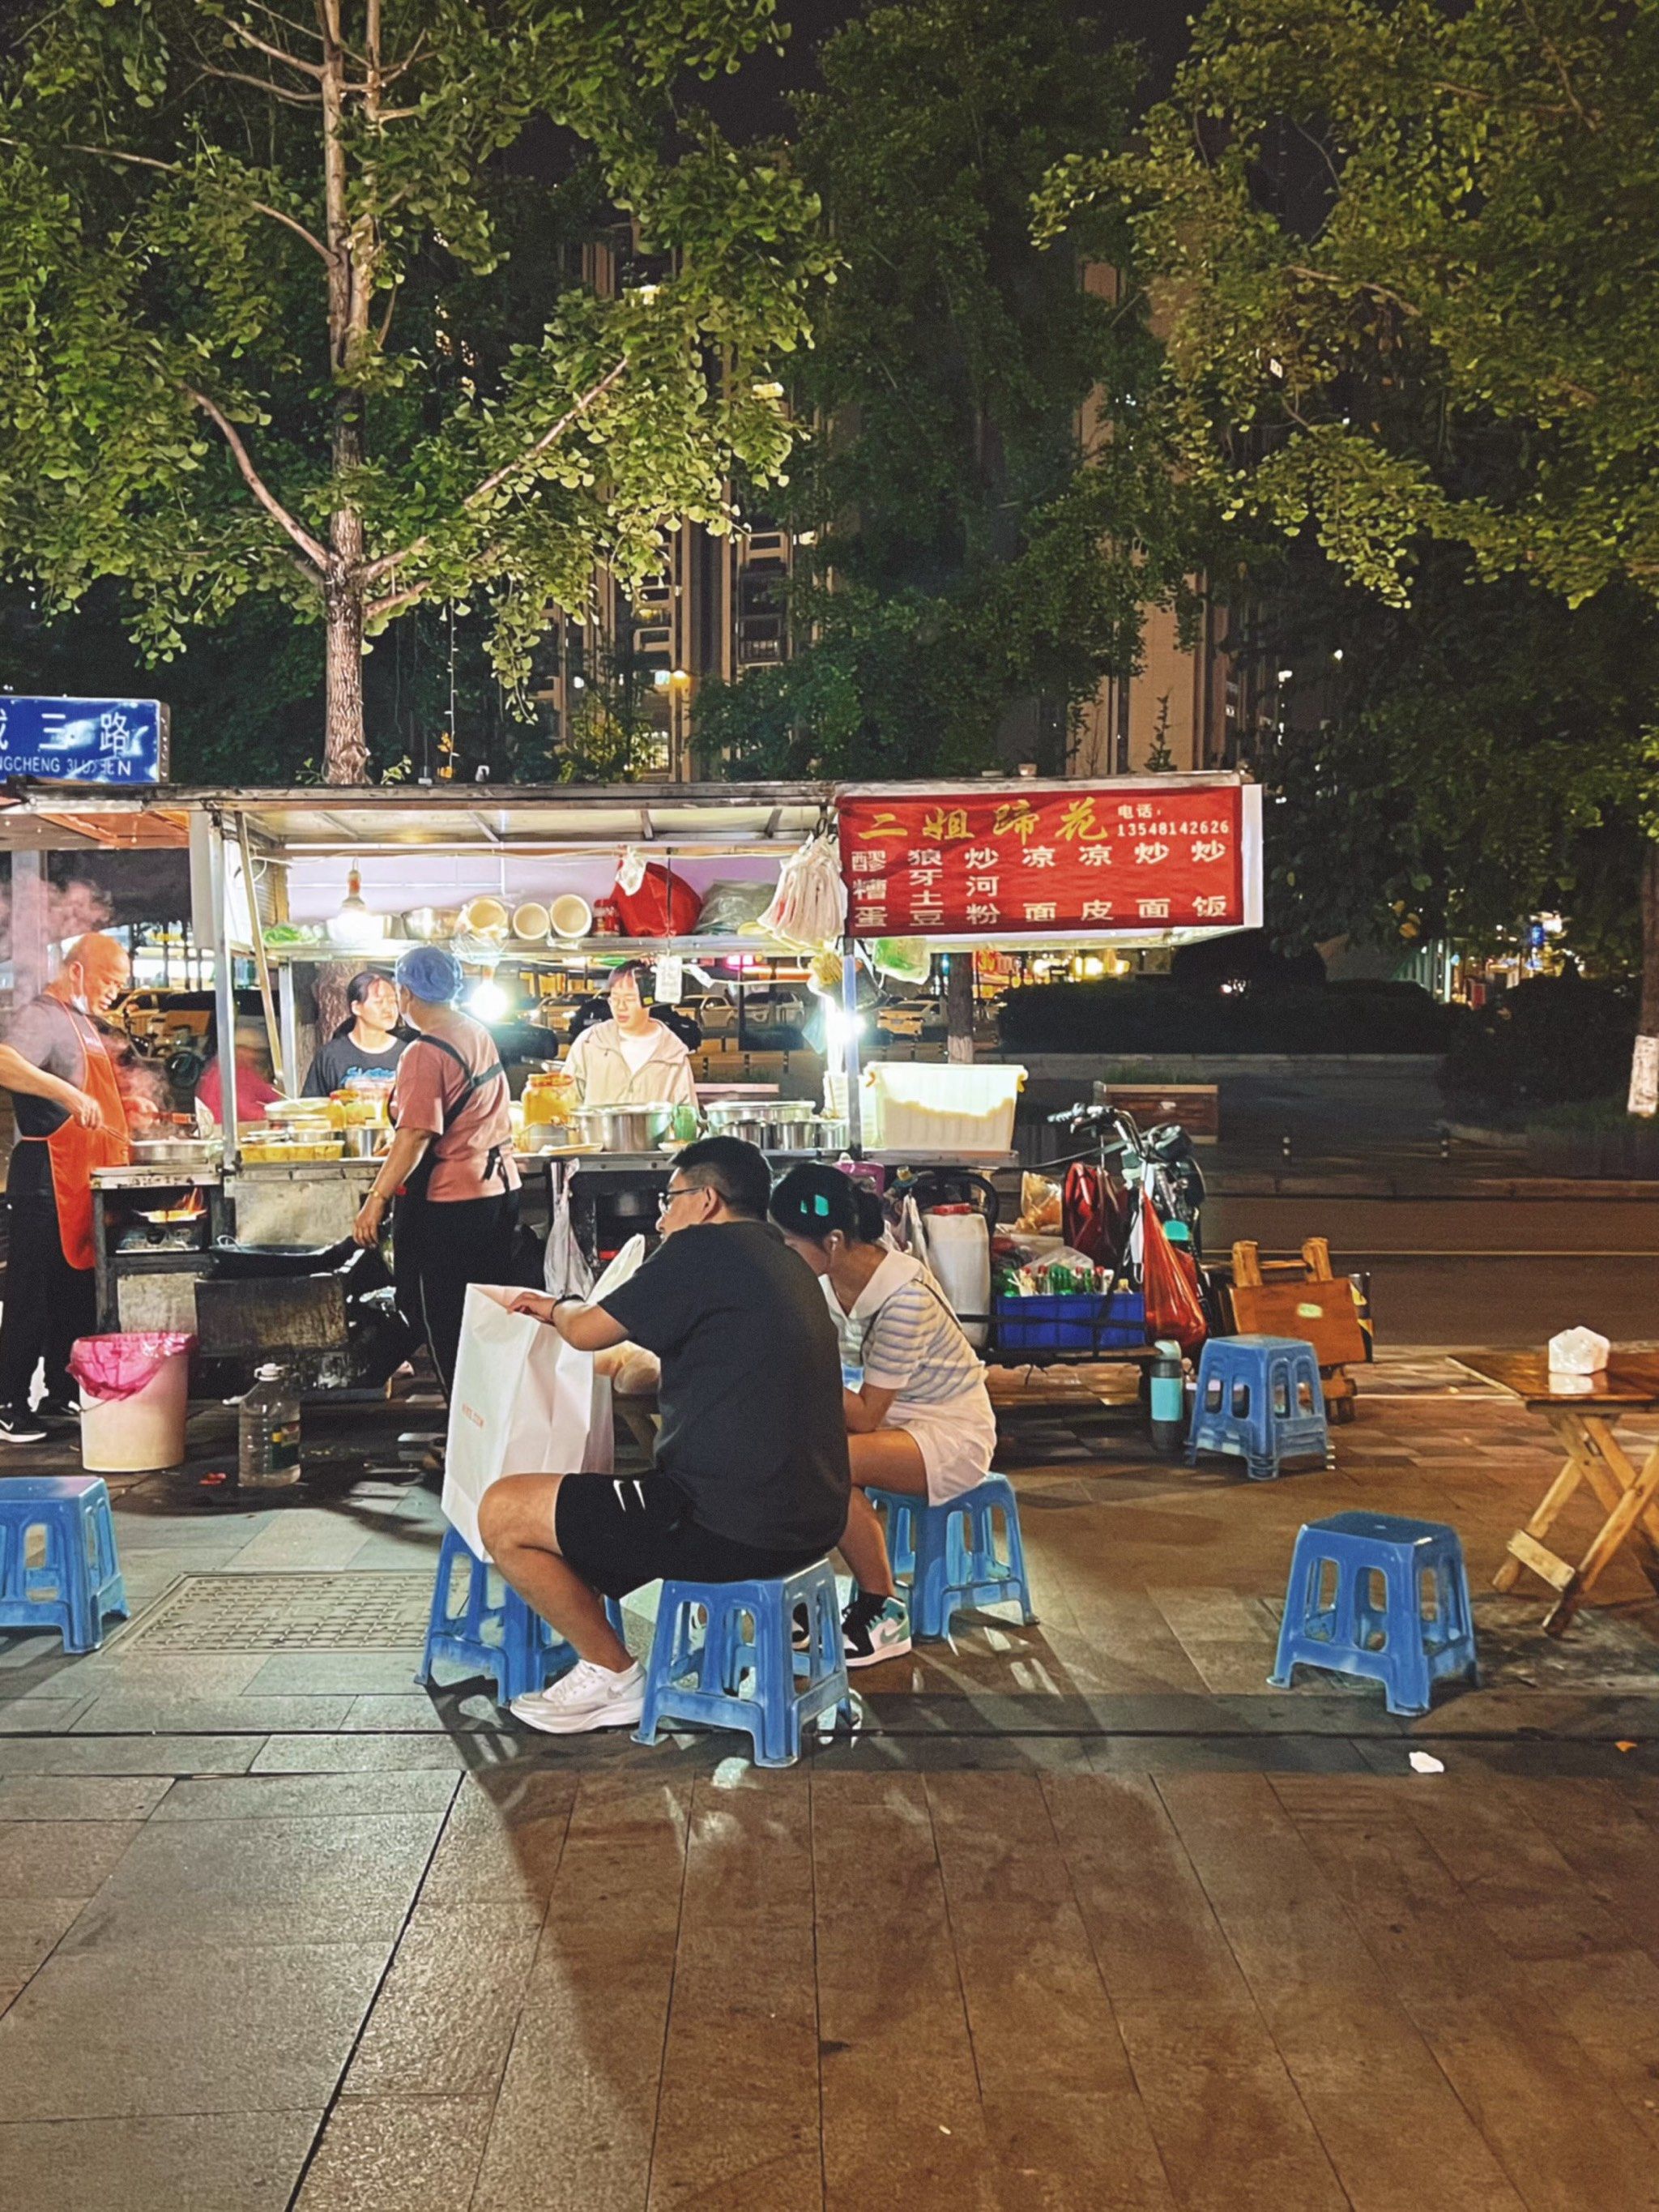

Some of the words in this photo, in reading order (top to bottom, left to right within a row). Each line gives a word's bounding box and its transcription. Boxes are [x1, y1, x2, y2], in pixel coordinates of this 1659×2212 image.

[117, 760, 131, 776] N
[858, 796, 1108, 845] 二姐蹄花
[1118, 820, 1229, 837] 13548142626
[907, 848, 945, 926] 狼牙土豆
[964, 847, 1001, 925] 炒河粉
[1022, 846, 1056, 922] 凉面
[1078, 843, 1114, 921] 凉皮
[1134, 841, 1171, 919] 炒面
[1191, 840, 1227, 918] 炒饭
